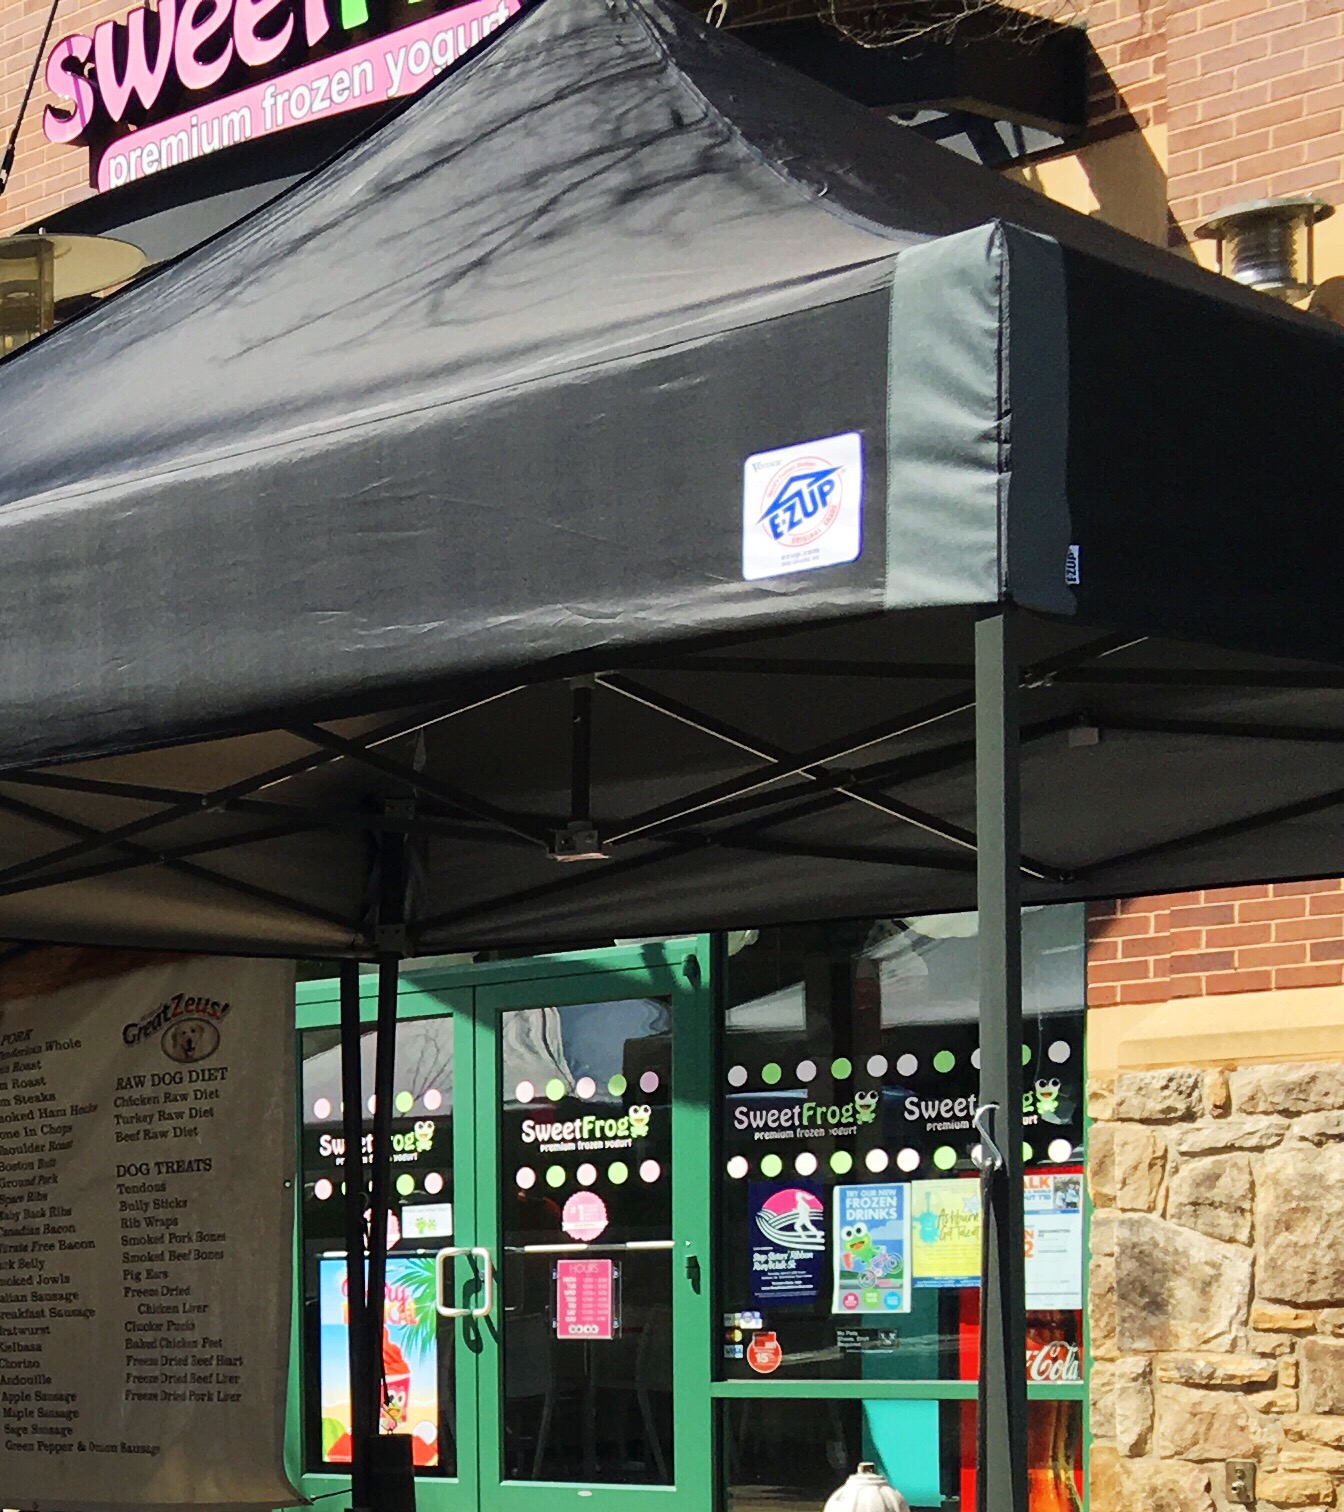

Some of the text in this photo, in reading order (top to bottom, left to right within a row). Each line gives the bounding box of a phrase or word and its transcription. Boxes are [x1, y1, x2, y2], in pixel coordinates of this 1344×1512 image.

[108, 4, 516, 188] premium frozen yogurt
[45, 1038, 82, 1052] Whole
[12, 1076, 47, 1089] Roast
[115, 1066, 229, 1091] RAW DOG DIET
[114, 1087, 220, 1109] Chicken Raw Diet
[38, 1106, 67, 1119] Ham
[115, 1106, 214, 1127] Turkey Raw Diet
[733, 1102, 854, 1131] SweetFrog
[23, 1127, 38, 1138] In
[143, 1128, 170, 1141] Raw
[172, 1125, 200, 1138] Diet
[521, 1117, 630, 1143] SweetFrog
[926, 1119, 970, 1133] premium
[753, 1128, 794, 1142] premium
[795, 1126, 825, 1139] frozen
[116, 1158, 213, 1178] DOG TREATS
[119, 1200, 150, 1213] Bully
[845, 1197, 898, 1209] FROZEN
[846, 1208, 898, 1221] DRINKS
[43, 1222, 77, 1235] Bacon
[121, 1215, 179, 1230] Rib Wraps
[58, 1238, 96, 1251] Bacon
